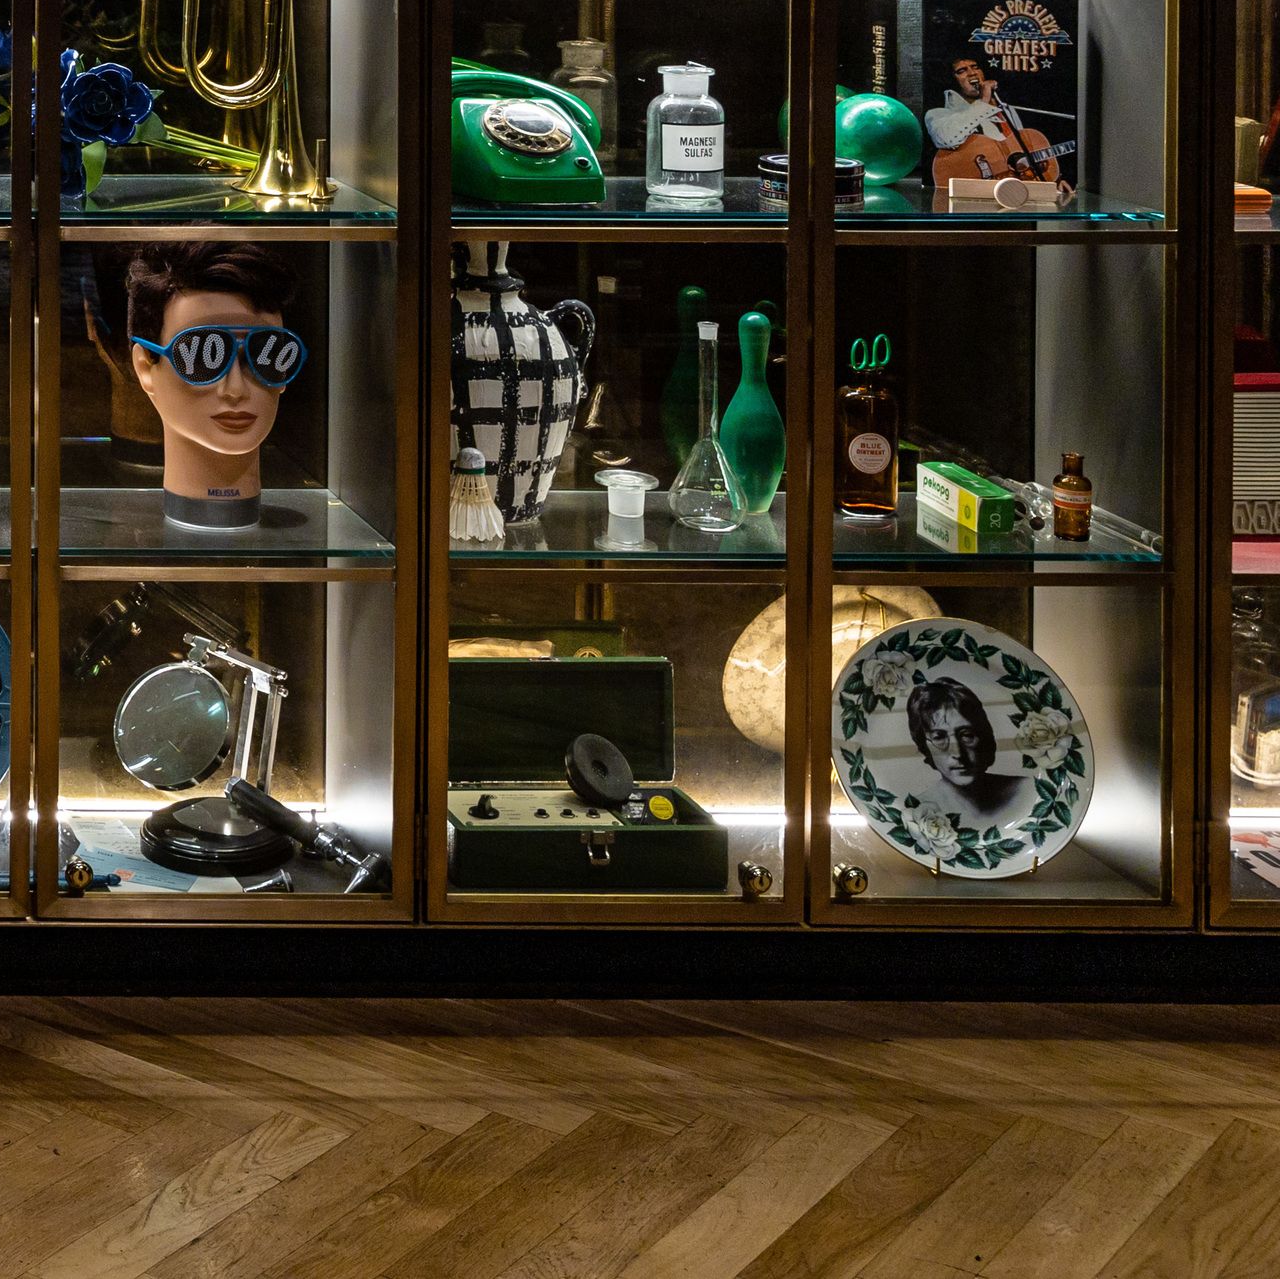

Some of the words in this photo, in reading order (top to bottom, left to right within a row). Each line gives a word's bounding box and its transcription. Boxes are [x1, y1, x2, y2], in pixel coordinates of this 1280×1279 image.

[981, 5, 1009, 35] ELVIS
[984, 39, 1058, 56] GREATEST
[1001, 55, 1041, 73] HITS
[684, 148, 713, 158] SULFAS
[178, 333, 225, 375] YO
[860, 442, 882, 450] BLUE
[207, 488, 241, 497] MELISSA
